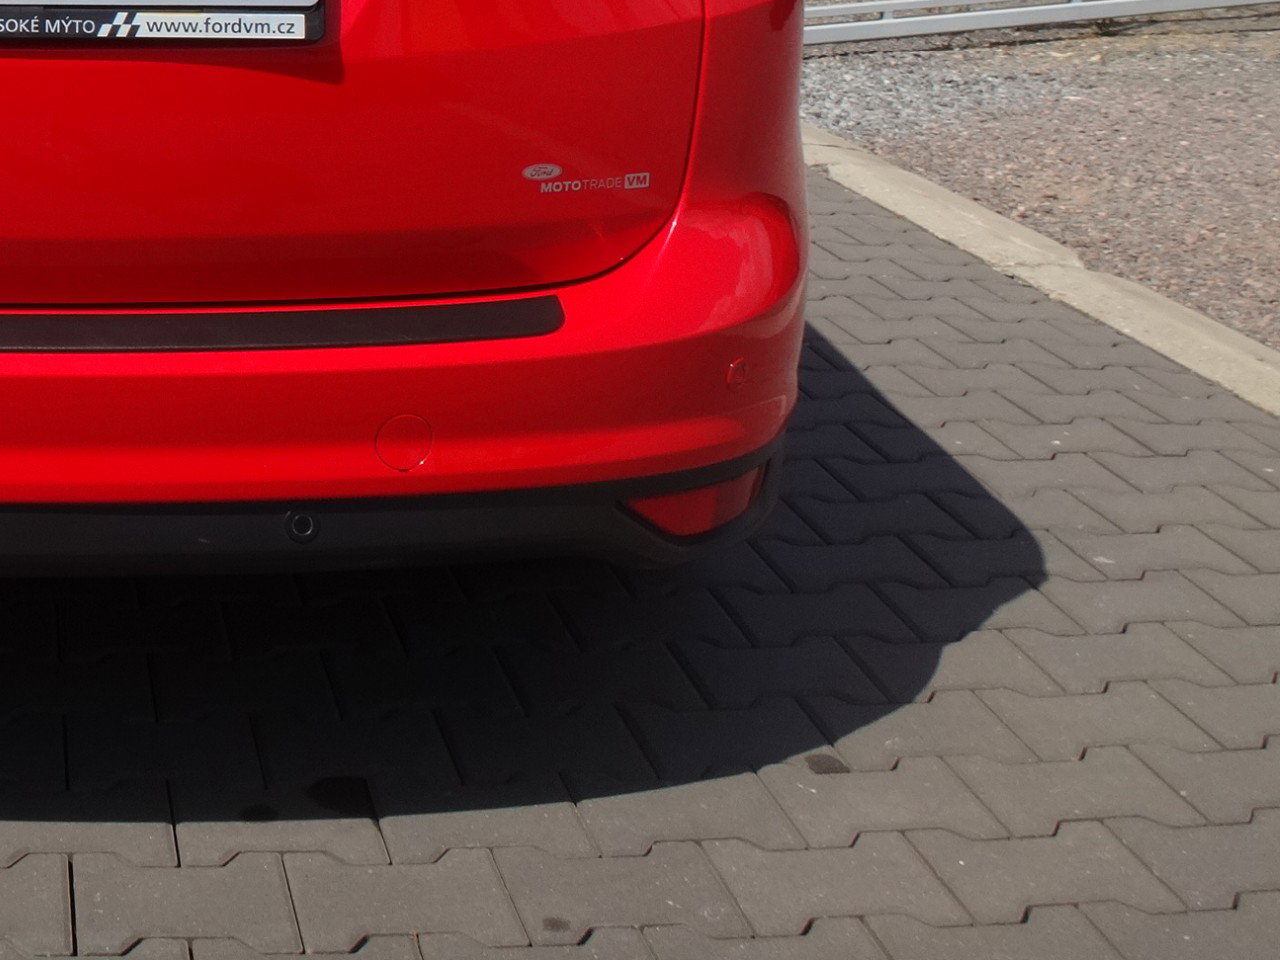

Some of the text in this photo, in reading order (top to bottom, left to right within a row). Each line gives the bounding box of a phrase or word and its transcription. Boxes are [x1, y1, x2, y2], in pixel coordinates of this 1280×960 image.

[45, 17, 96, 33] MÝTO
[146, 18, 295, 34] www.fordvm.cz
[626, 174, 648, 188] VM
